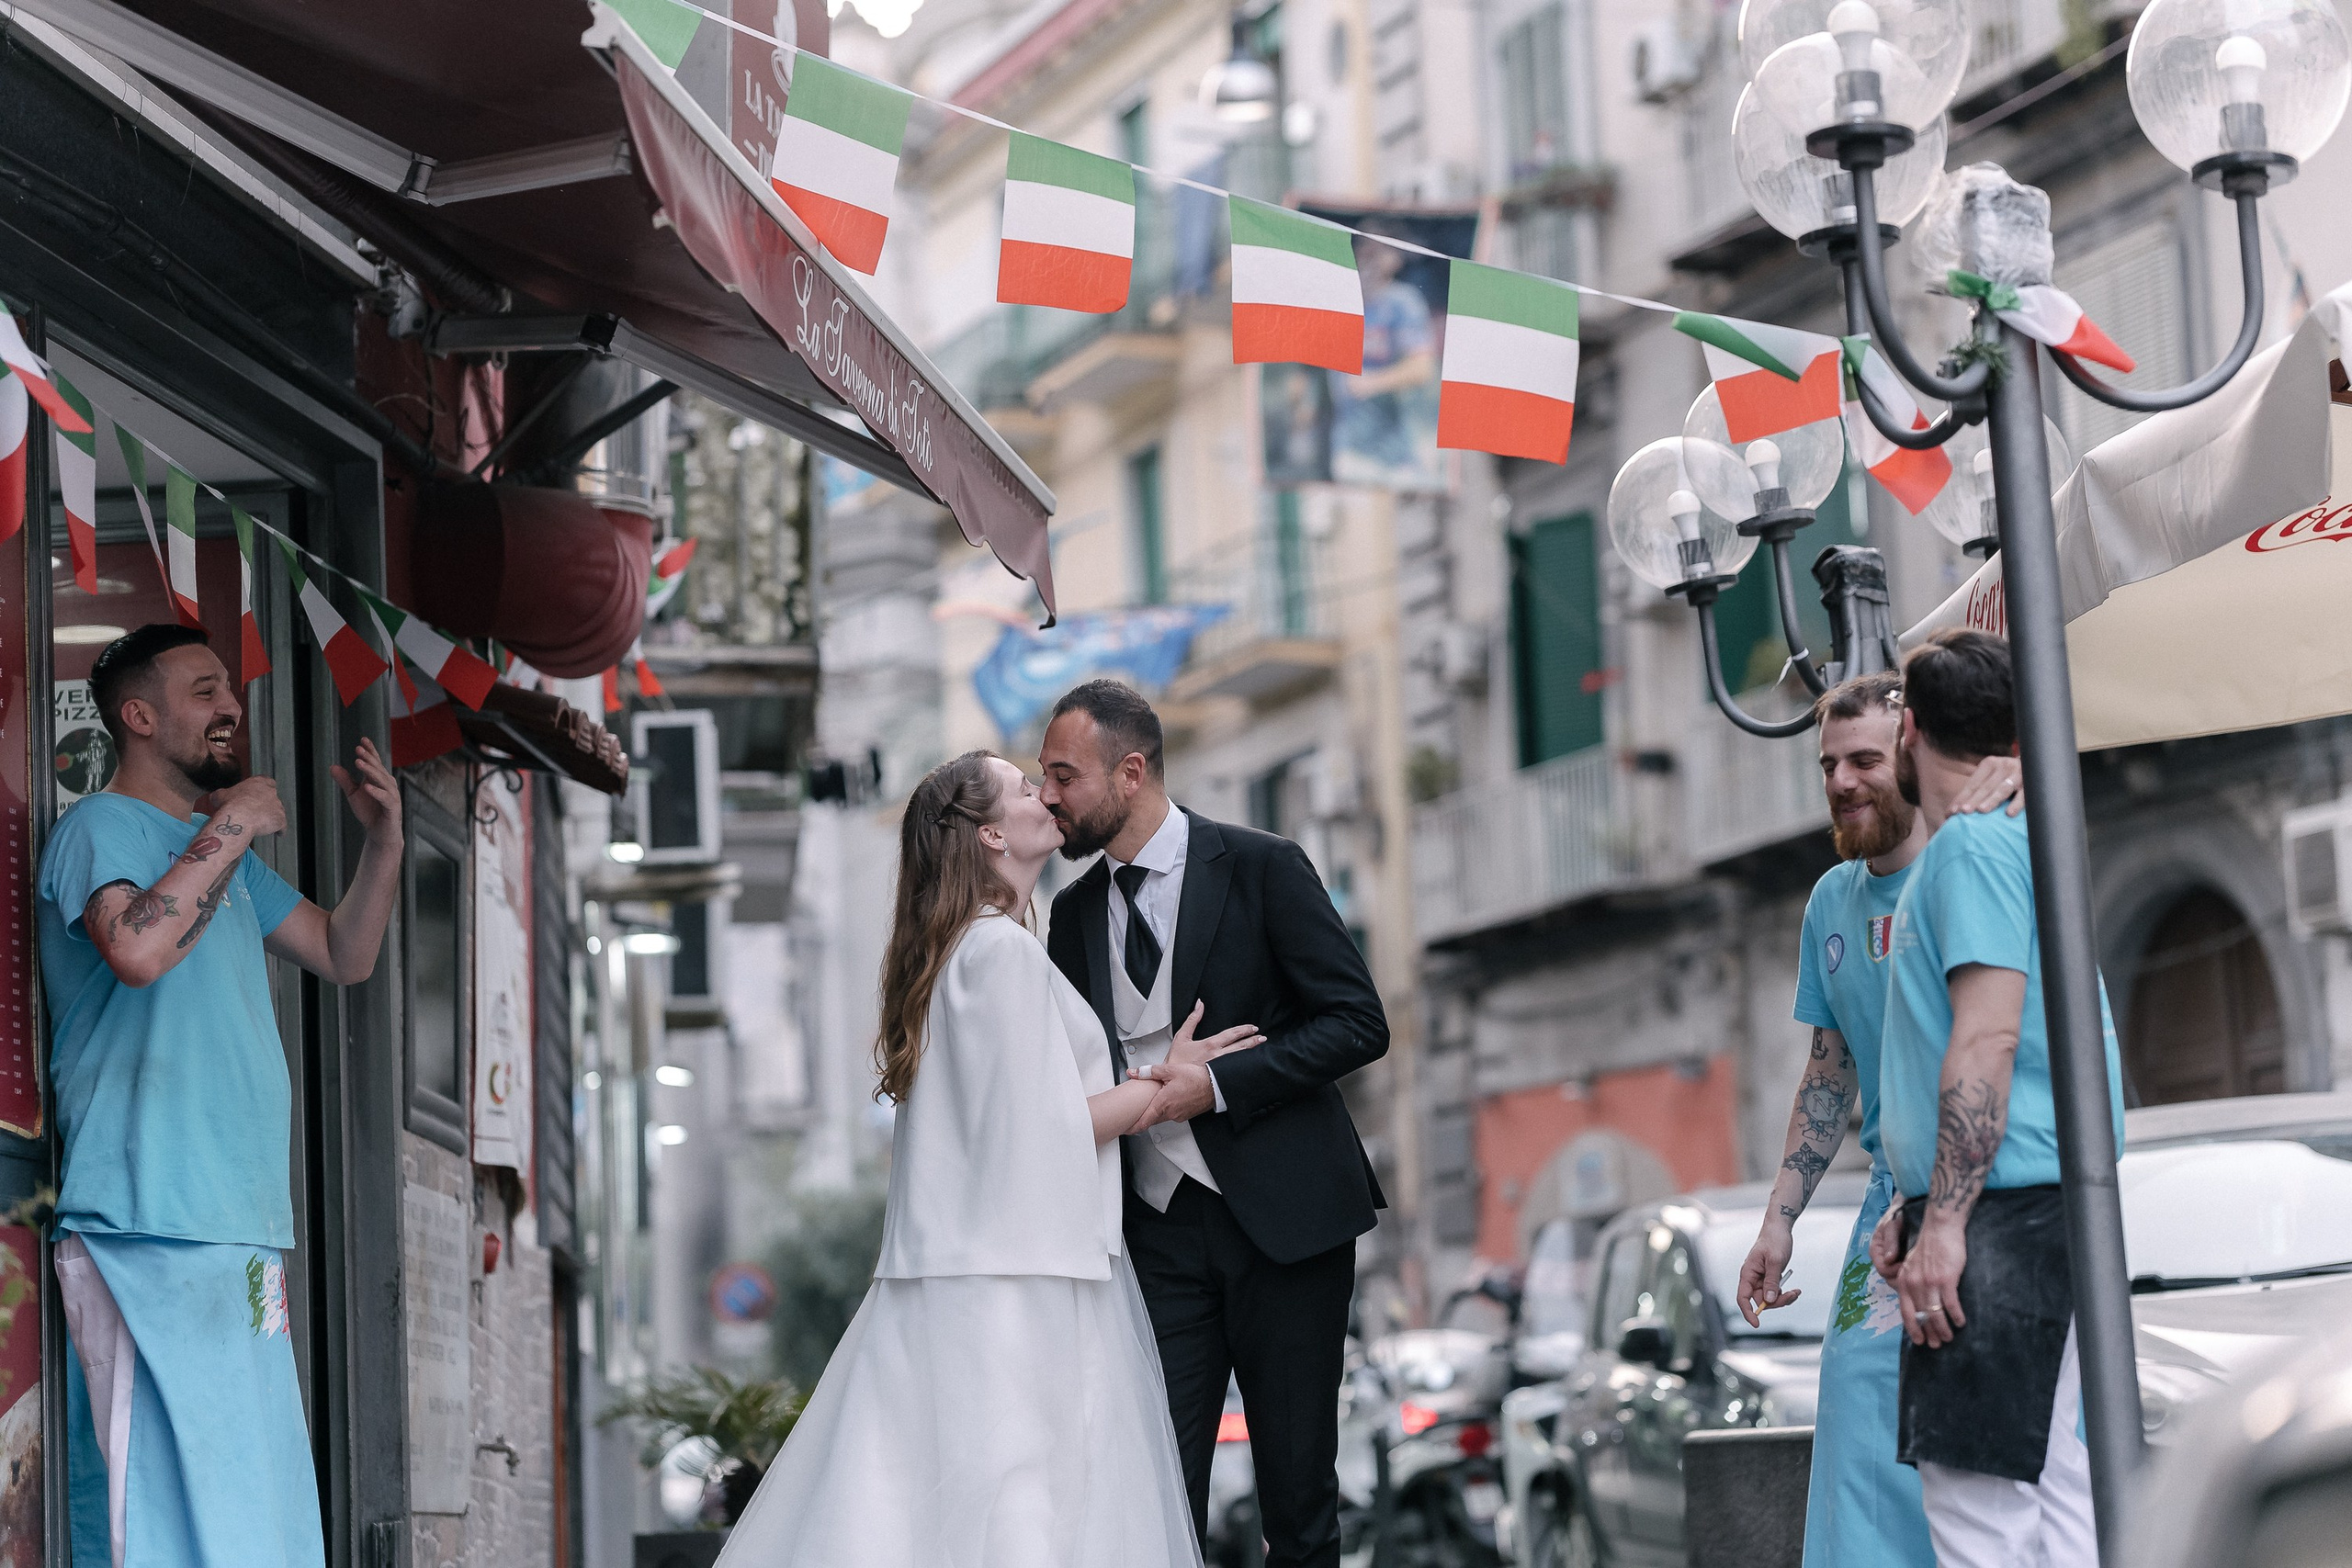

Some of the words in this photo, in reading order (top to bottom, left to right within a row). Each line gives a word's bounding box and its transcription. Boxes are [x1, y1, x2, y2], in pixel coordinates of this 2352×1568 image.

[793, 255, 821, 361] La
[824, 297, 885, 425] Taverna
[888, 369, 900, 440] di
